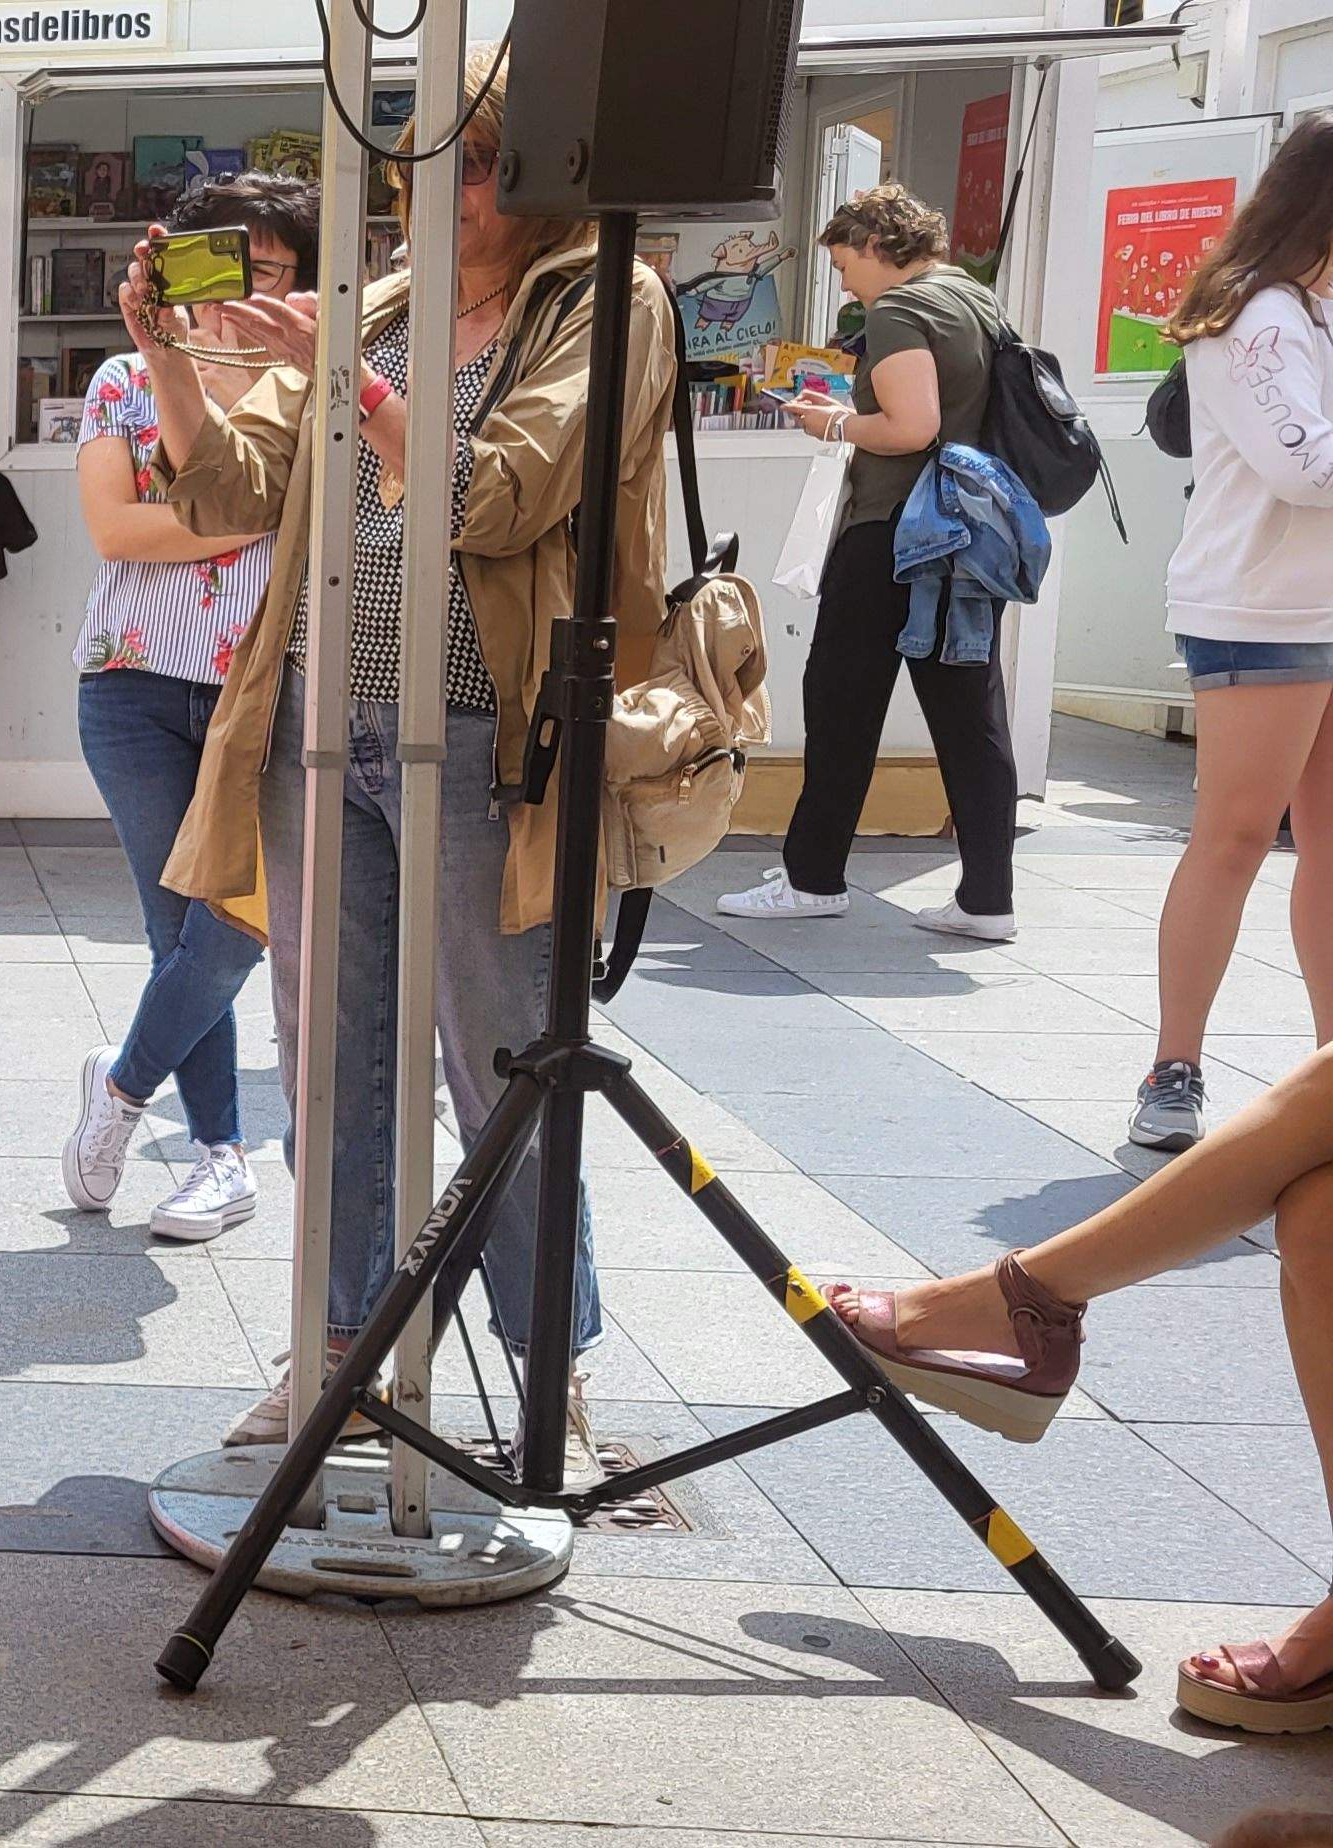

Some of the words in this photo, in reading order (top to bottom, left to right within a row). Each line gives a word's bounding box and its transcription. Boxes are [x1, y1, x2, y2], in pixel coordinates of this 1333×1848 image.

[715, 331, 733, 345] AL
[1246, 366, 1320, 471] MOUSE
[399, 1178, 473, 1277] VONYX
